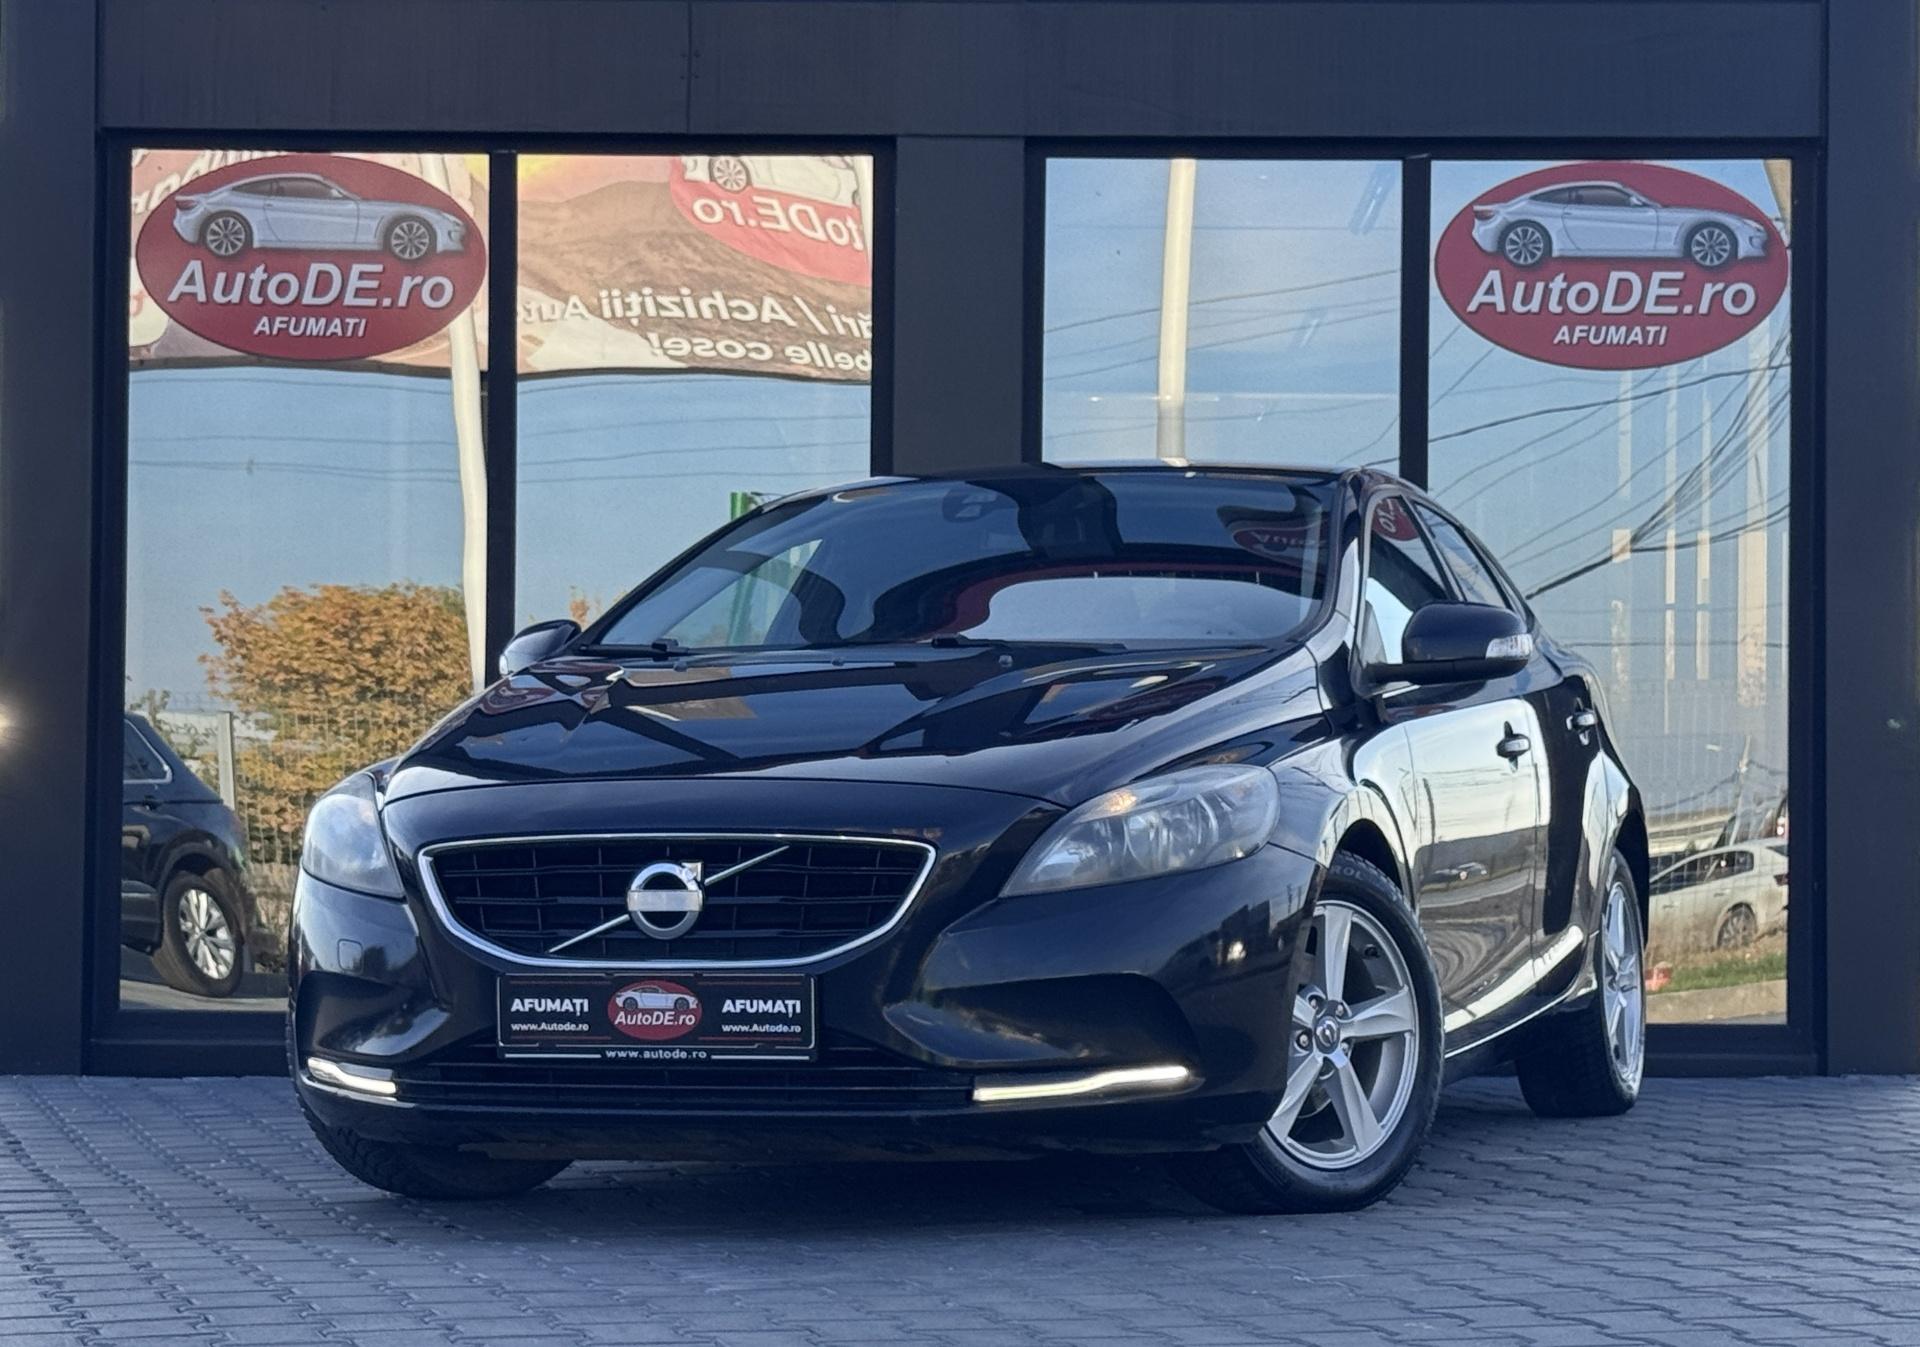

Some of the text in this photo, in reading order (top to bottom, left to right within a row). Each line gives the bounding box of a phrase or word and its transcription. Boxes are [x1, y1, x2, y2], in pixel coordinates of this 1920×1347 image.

[167, 259, 455, 309] AutoDE.ro
[1466, 269, 1757, 316] AutoDE.ro
[253, 315, 367, 338] AFUMATI
[1552, 324, 1668, 346] AFUMATI
[510, 1021, 590, 1032] www.Autode.ro
[614, 1010, 696, 1026] AutoDE.ro
[721, 1023, 802, 1033] www.Autode.ro
[605, 1049, 708, 1060] www.autode.ro
